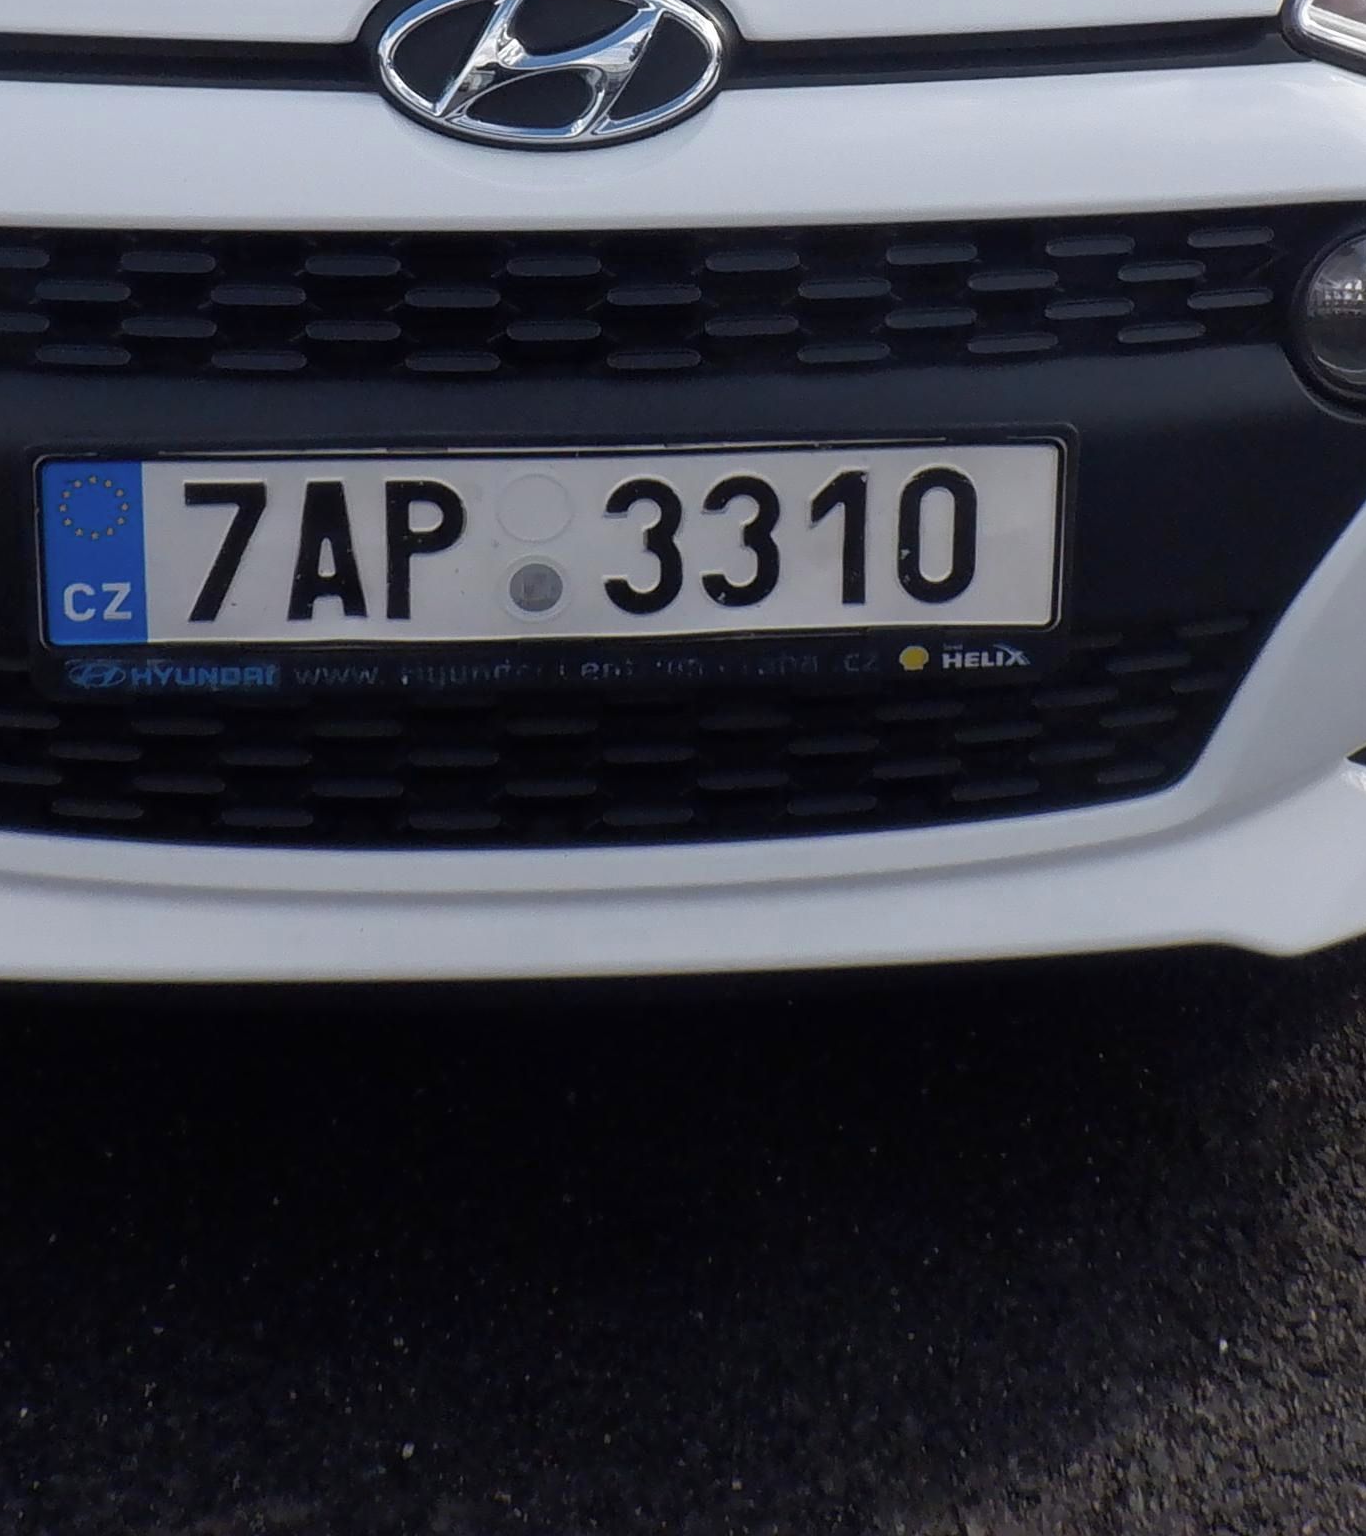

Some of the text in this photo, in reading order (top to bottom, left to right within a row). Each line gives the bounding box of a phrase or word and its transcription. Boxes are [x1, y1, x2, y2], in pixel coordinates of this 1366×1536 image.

[184, 467, 977, 622] 7AP 3310
[63, 582, 133, 622] CZ
[942, 647, 1030, 669] HELIX
[133, 665, 277, 687] HYUNDAI
